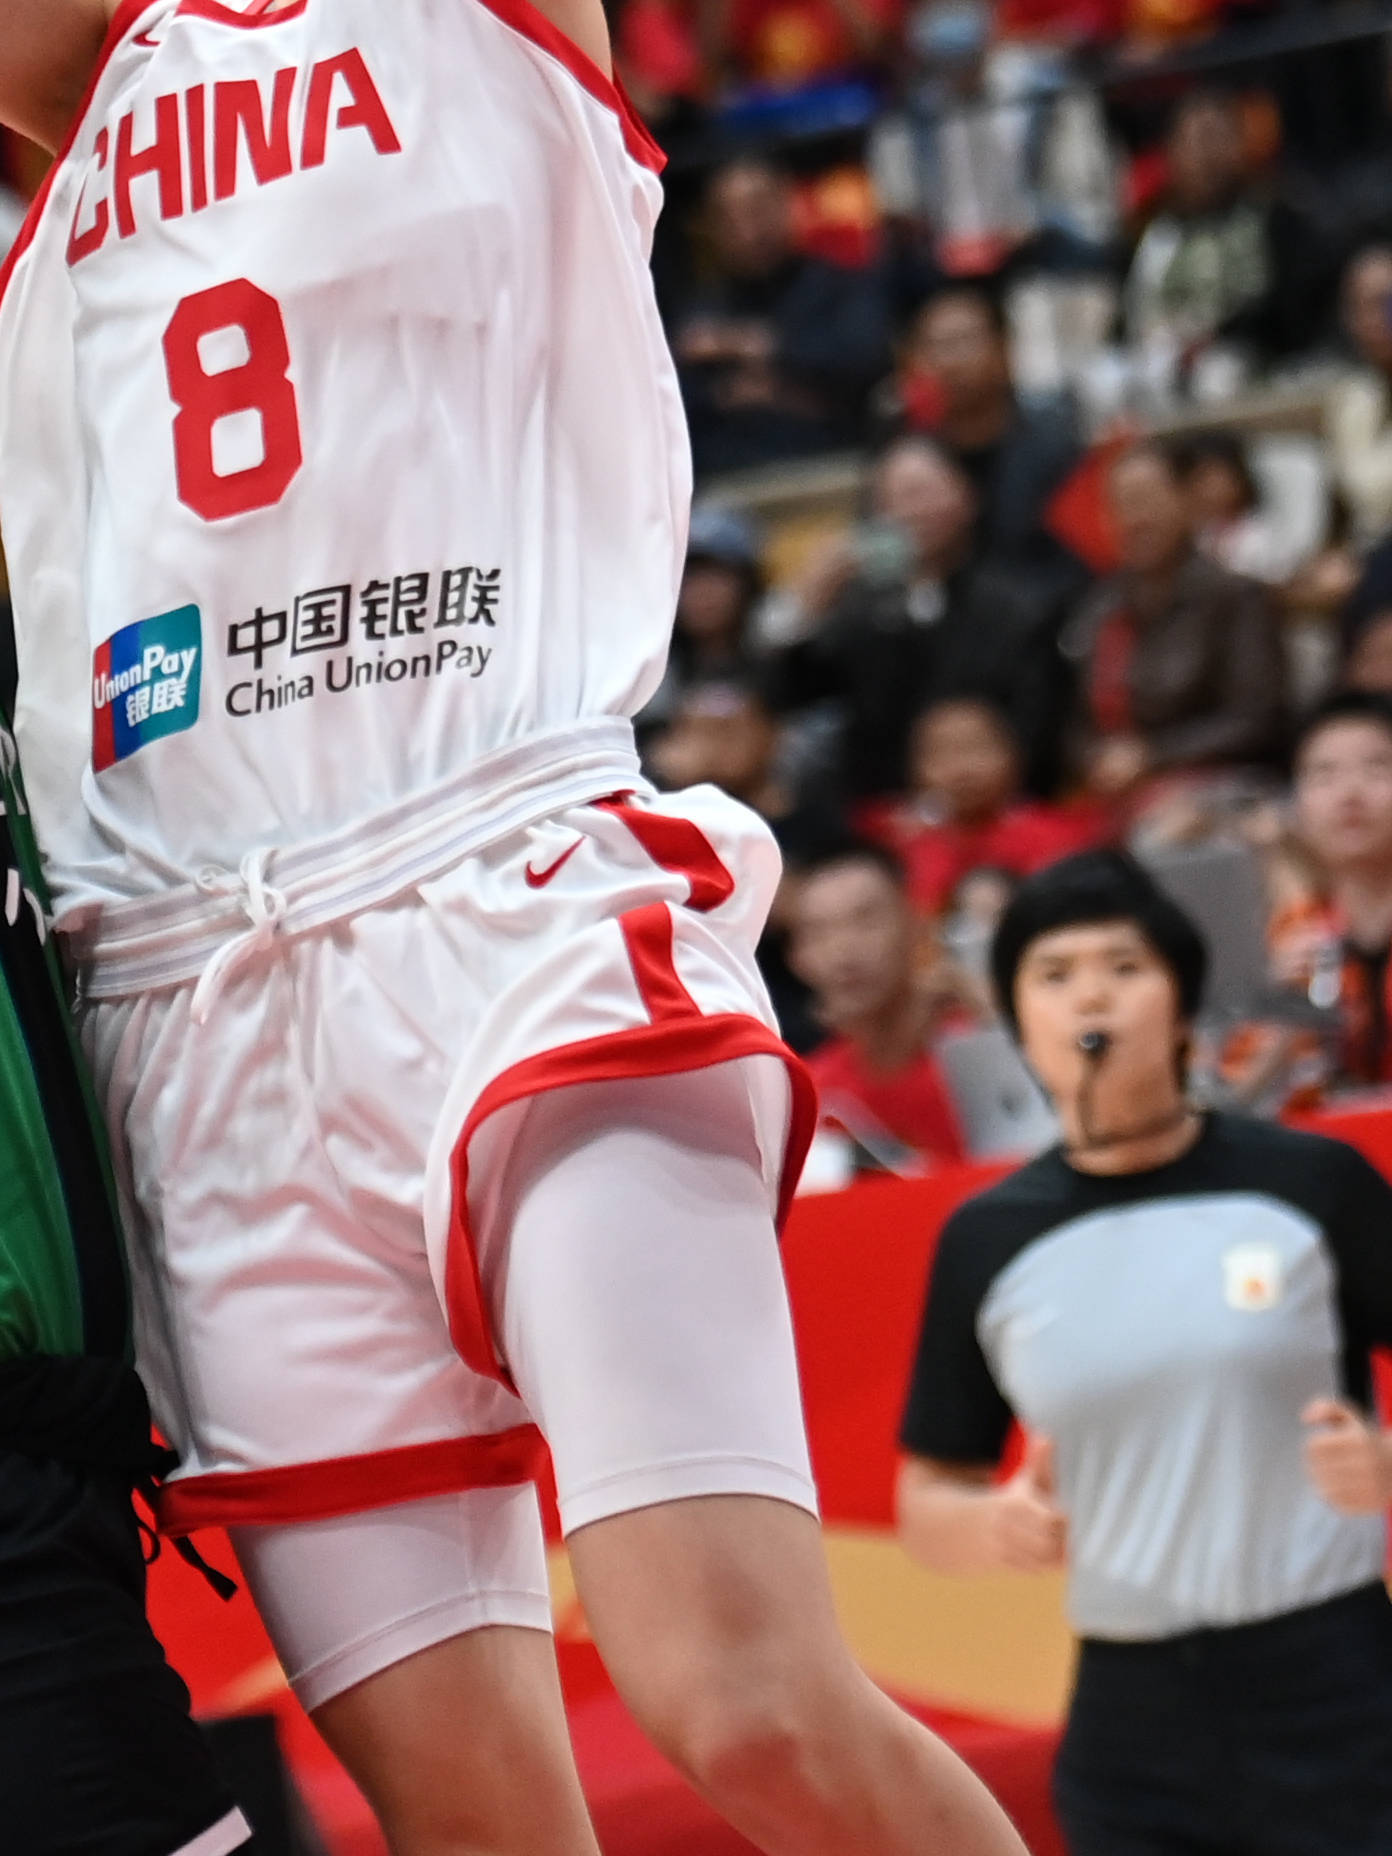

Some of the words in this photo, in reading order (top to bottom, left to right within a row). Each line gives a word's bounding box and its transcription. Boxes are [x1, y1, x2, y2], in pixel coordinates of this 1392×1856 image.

[64, 46, 403, 268] CHINA
[161, 276, 303, 523] 8
[226, 566, 502, 671] 中国银联
[92, 644, 198, 710] UnionPay
[124, 677, 189, 728] 银联
[224, 670, 315, 718] China
[325, 638, 493, 694] UnionPay
